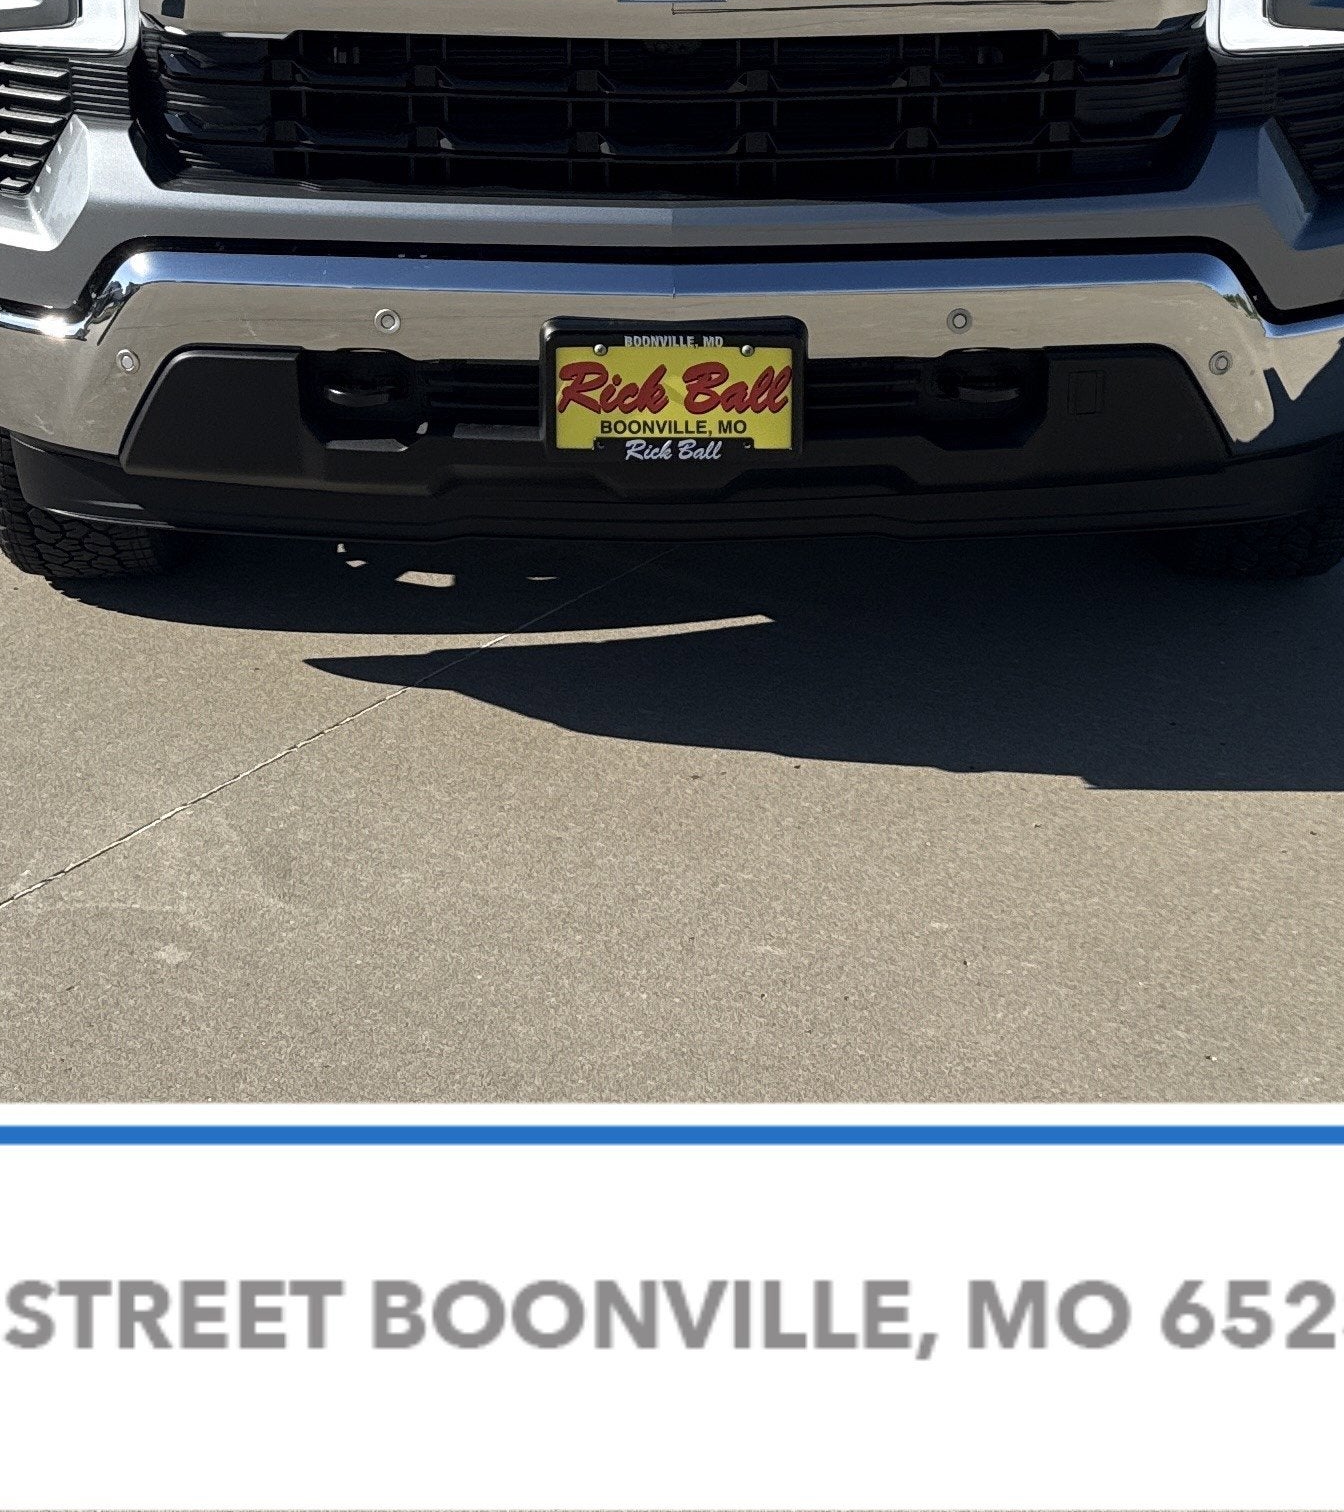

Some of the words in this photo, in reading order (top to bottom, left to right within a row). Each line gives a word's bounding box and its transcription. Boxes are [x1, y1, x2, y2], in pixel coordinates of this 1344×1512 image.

[624, 336, 698, 349] BOONVILLE,
[703, 336, 724, 348] MO
[558, 361, 670, 414] Rick
[682, 361, 792, 415] Ball
[600, 420, 712, 436] BOONVILLE,
[718, 420, 747, 434] MO
[625, 439, 673, 461] Rick
[678, 440, 722, 460] Ball
